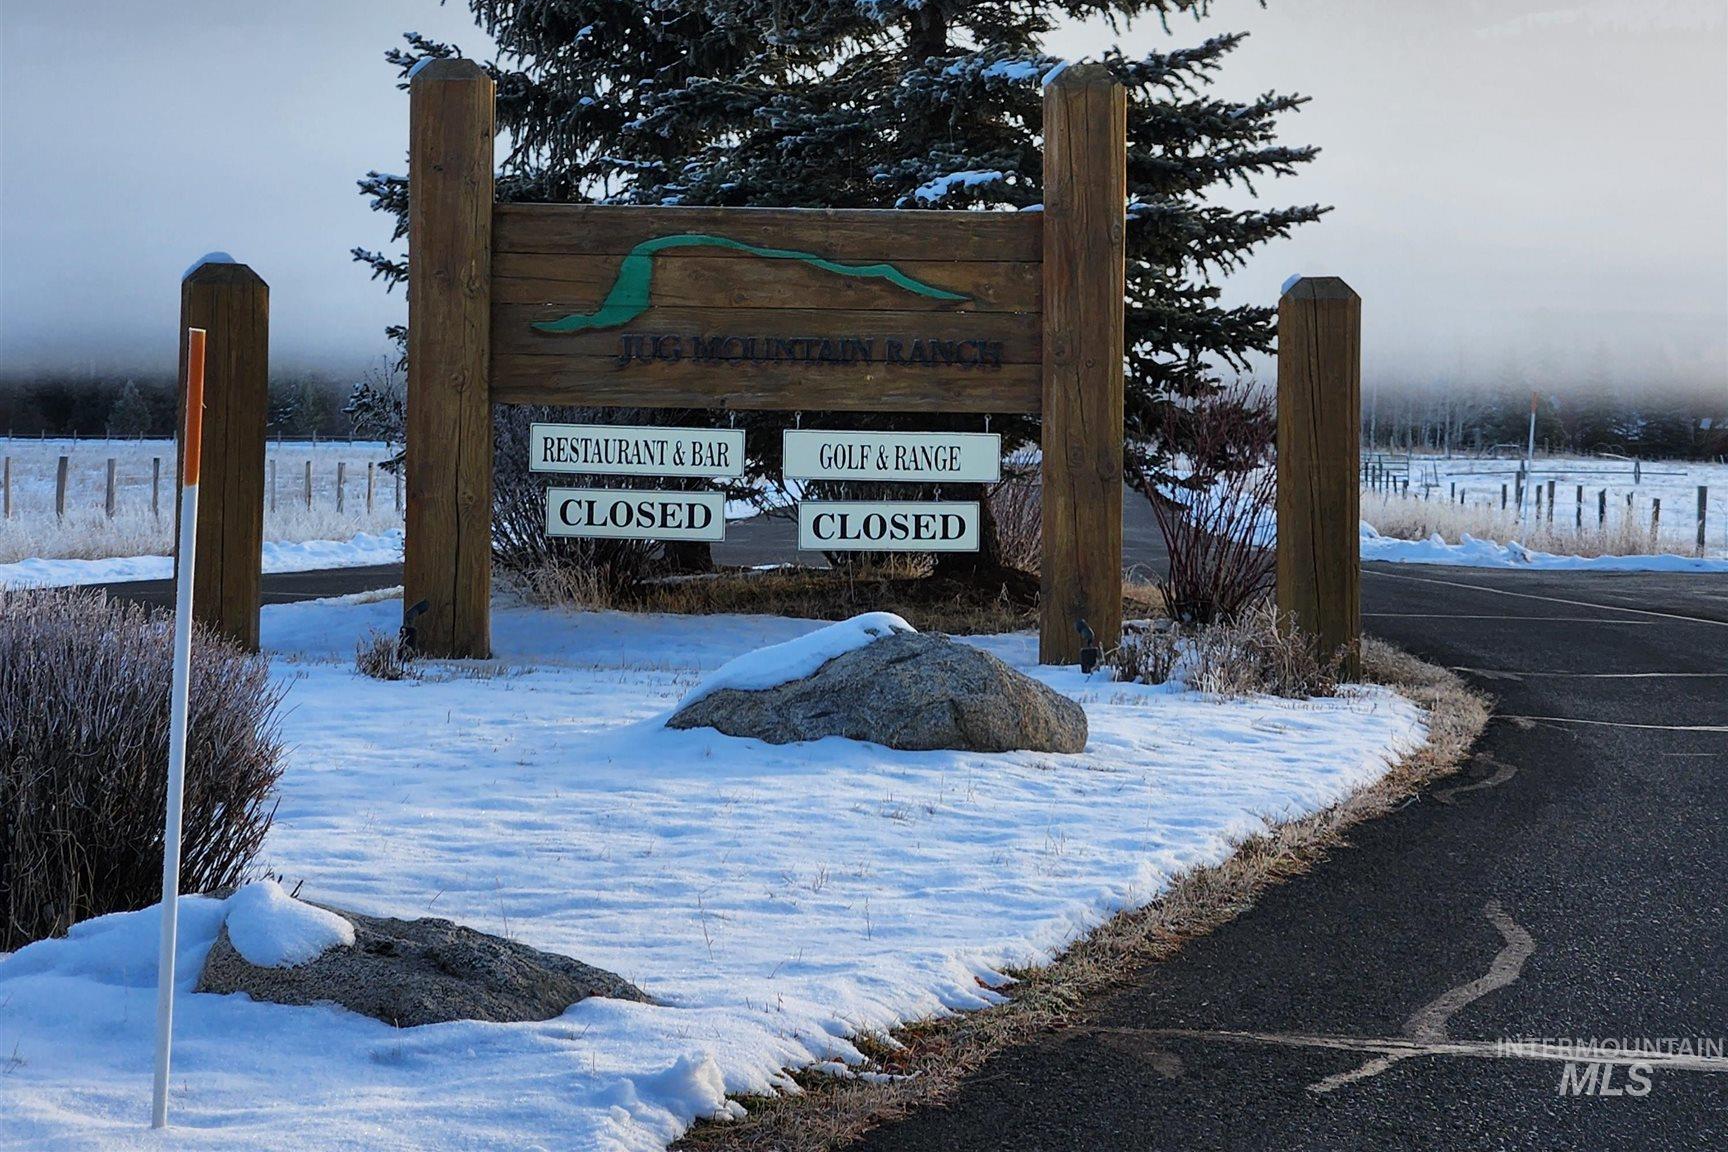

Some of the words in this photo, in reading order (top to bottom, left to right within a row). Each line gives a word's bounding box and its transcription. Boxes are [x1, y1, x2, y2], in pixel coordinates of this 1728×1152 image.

[616, 333, 680, 366] JUG
[691, 335, 874, 366] MOUNTAIN
[884, 336, 1004, 369] RANCH
[541, 436, 668, 467] RESTAURANT
[672, 440, 686, 466] &
[692, 440, 730, 468] BAR
[819, 443, 871, 471] GOLF
[876, 444, 889, 471] &
[894, 444, 962, 472] RANGE
[558, 498, 713, 530] CLOSED
[812, 512, 967, 541] CLOSED
